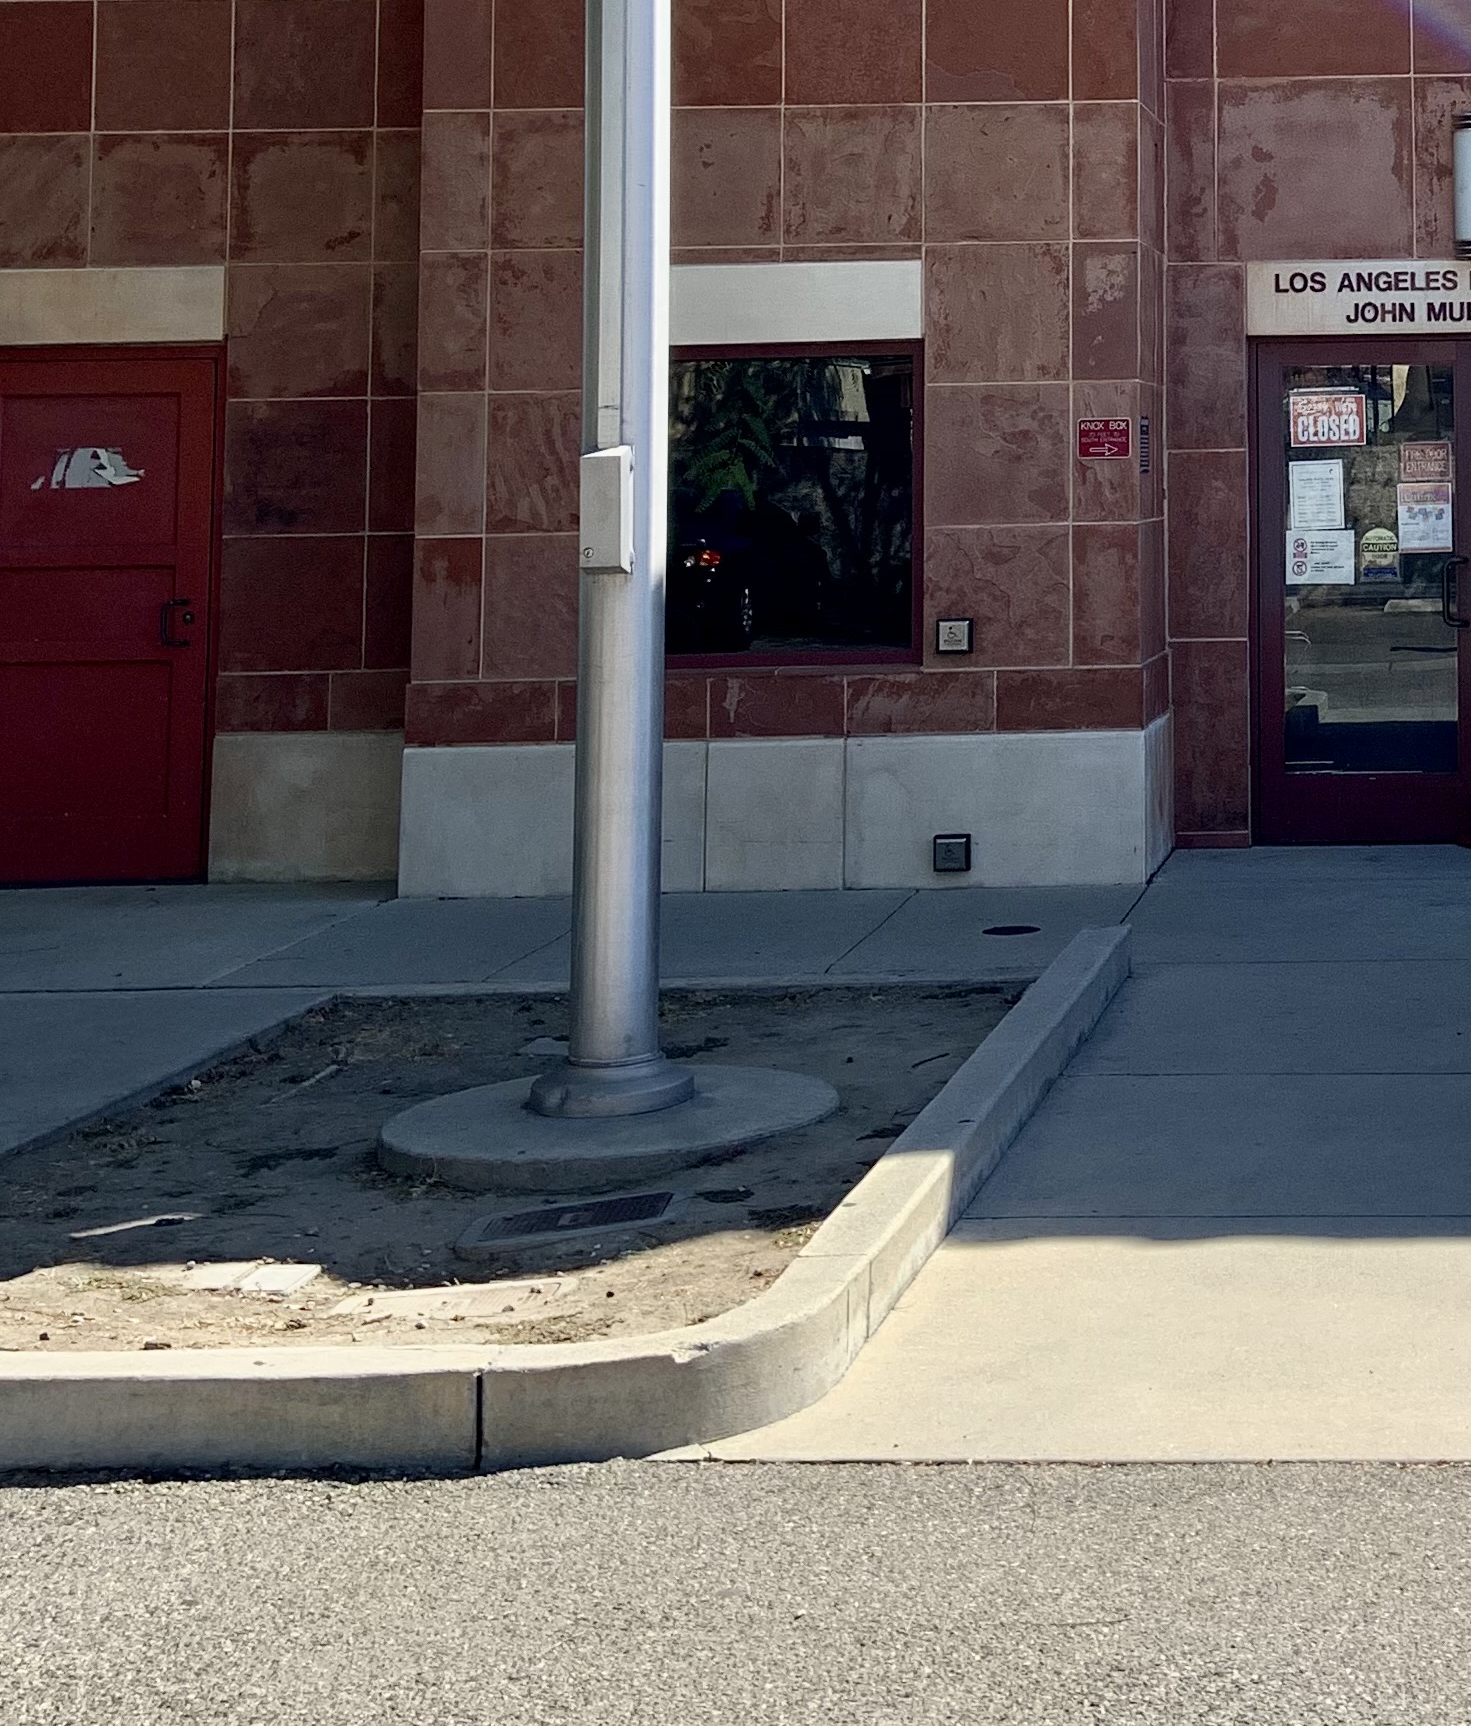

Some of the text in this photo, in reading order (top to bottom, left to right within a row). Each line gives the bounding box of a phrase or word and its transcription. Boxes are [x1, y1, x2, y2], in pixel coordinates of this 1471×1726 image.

[1274, 271, 1327, 293] LOS
[1337, 270, 1458, 292] ANGELES
[1345, 301, 1416, 323] JOHN
[1080, 421, 1128, 430] KNOX BOX
[1297, 414, 1360, 441] CLOSED
[1362, 543, 1397, 552] CAUTION
